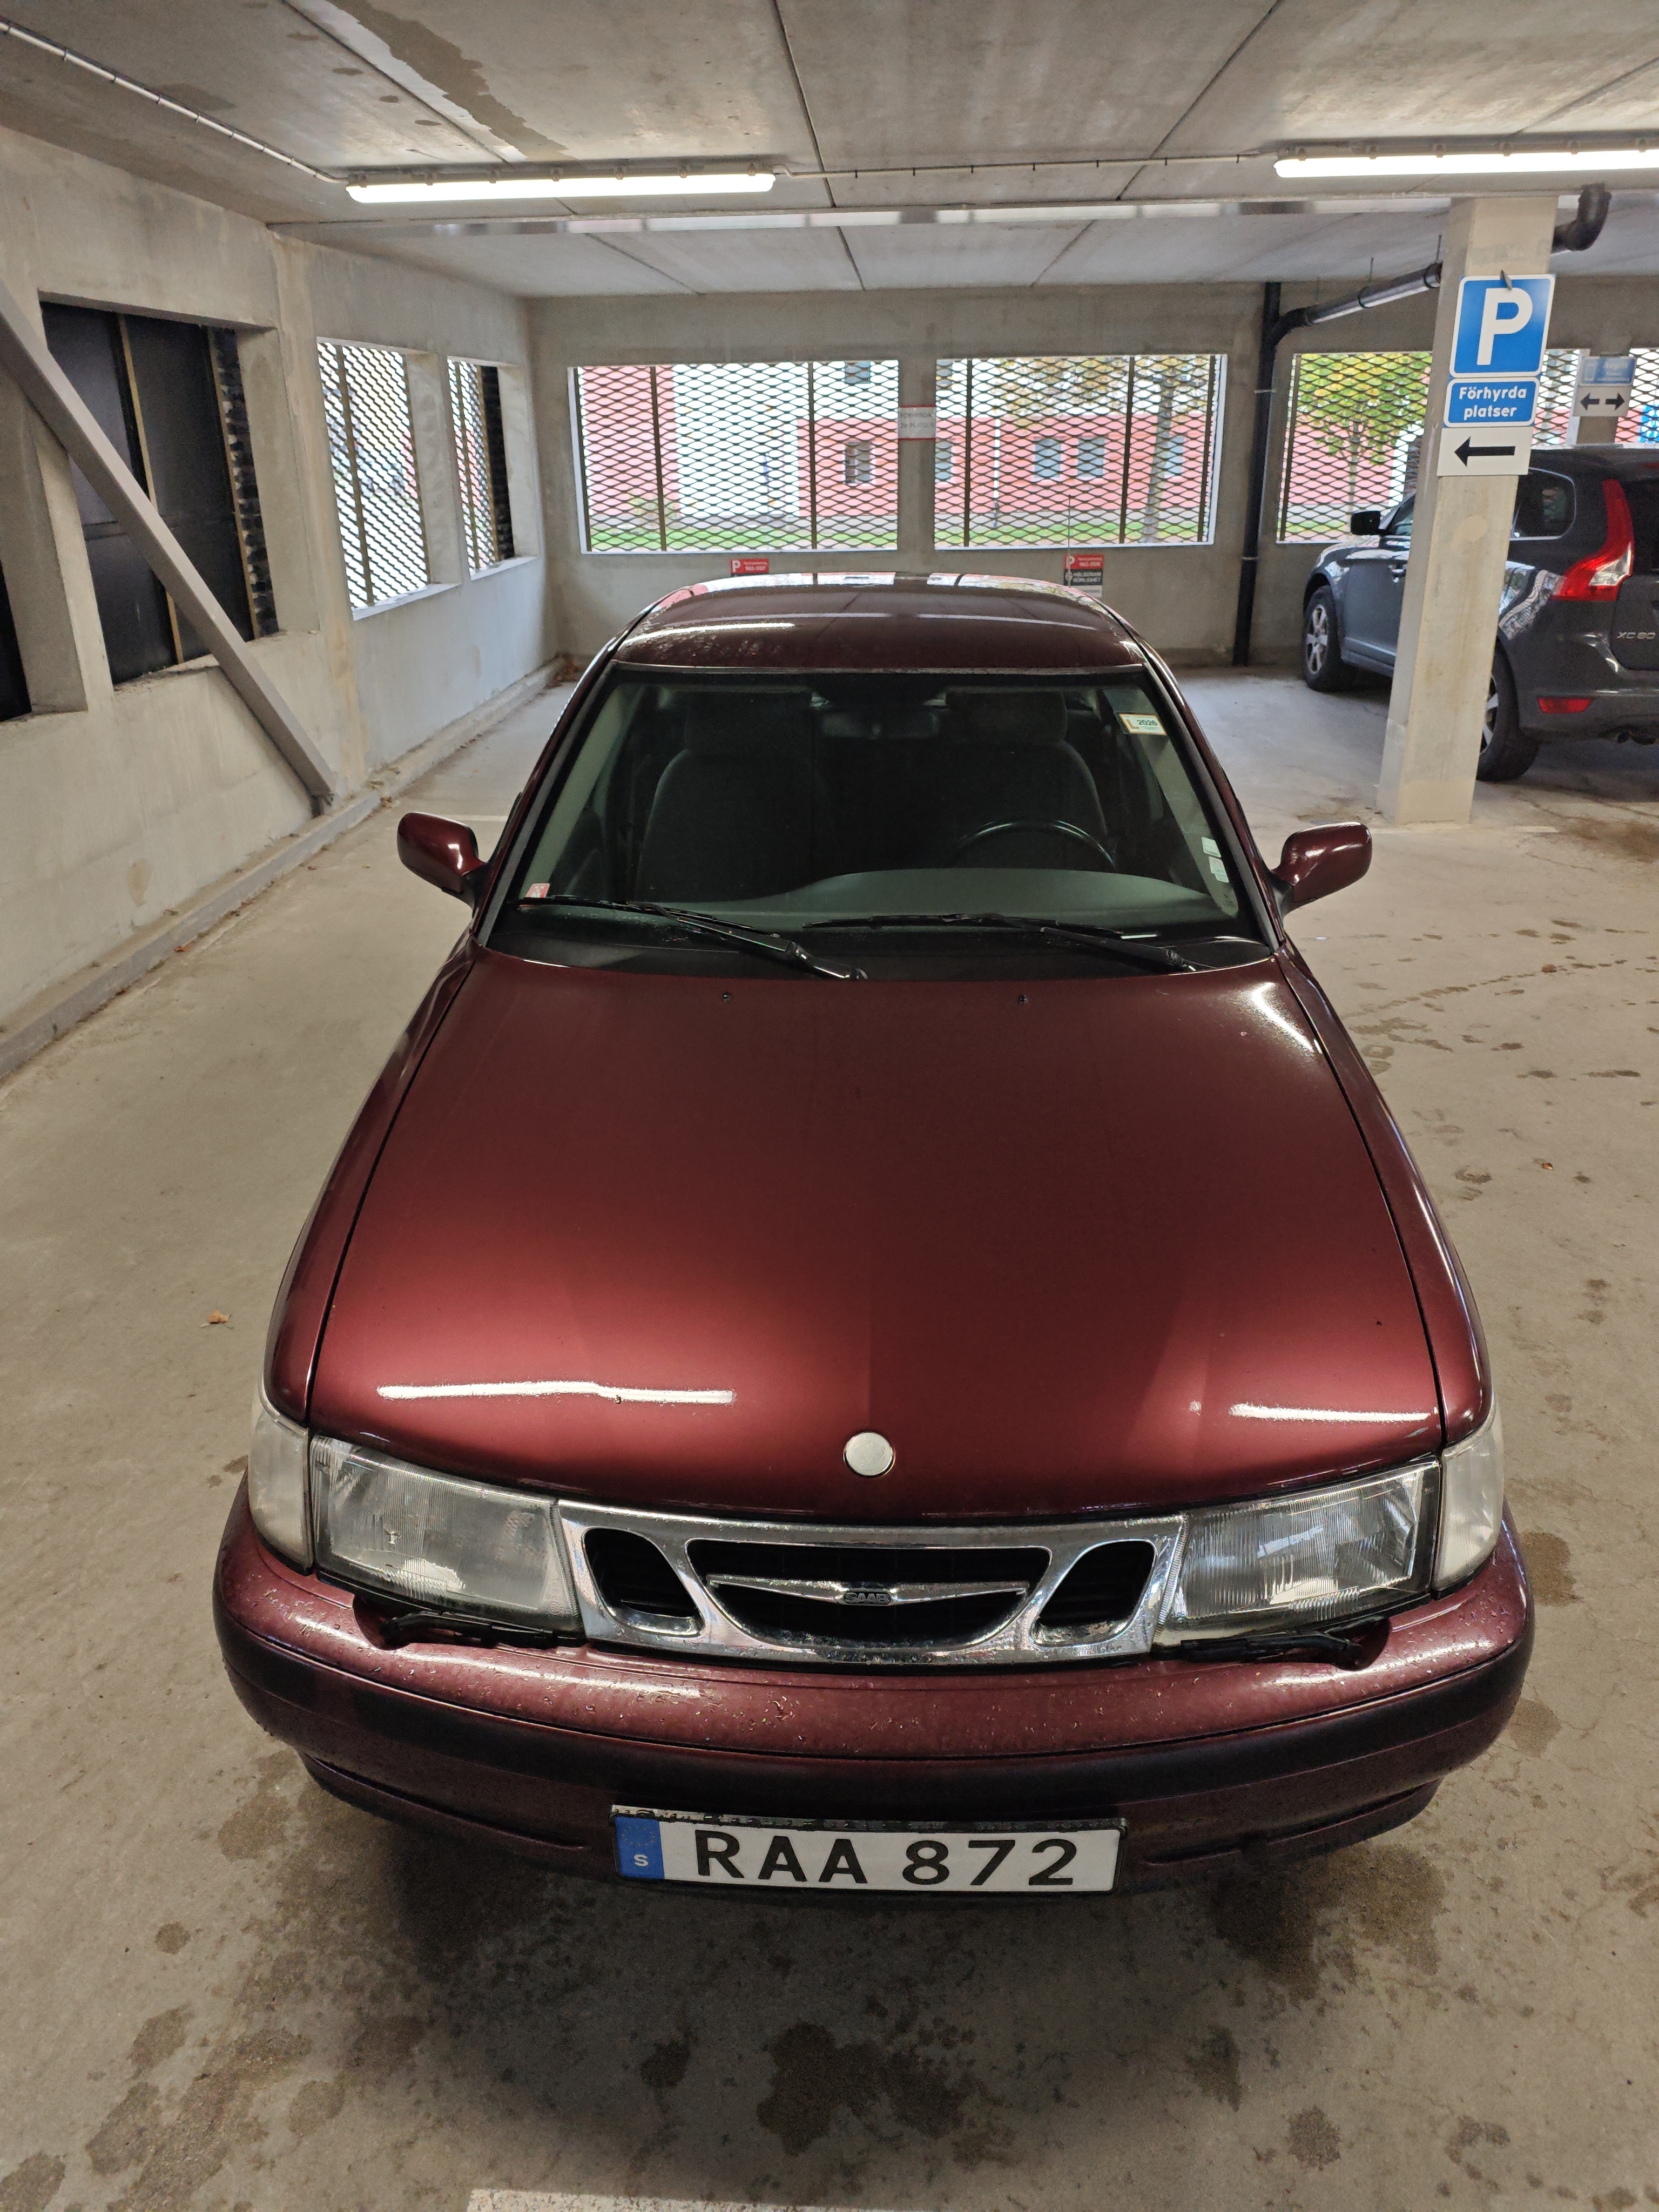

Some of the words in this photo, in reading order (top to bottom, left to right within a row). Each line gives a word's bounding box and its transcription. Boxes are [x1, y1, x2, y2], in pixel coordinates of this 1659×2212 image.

[1476, 287, 1533, 365] P
[1459, 385, 1527, 402] Förhyrda
[1463, 404, 1518, 421] platser
[732, 560, 741, 572] P
[1616, 632, 1656, 640] XC60
[844, 1592, 891, 1604] SAAB
[633, 1853, 649, 1867] S
[694, 1829, 868, 1884] RAA
[902, 1838, 1077, 1886] 872
